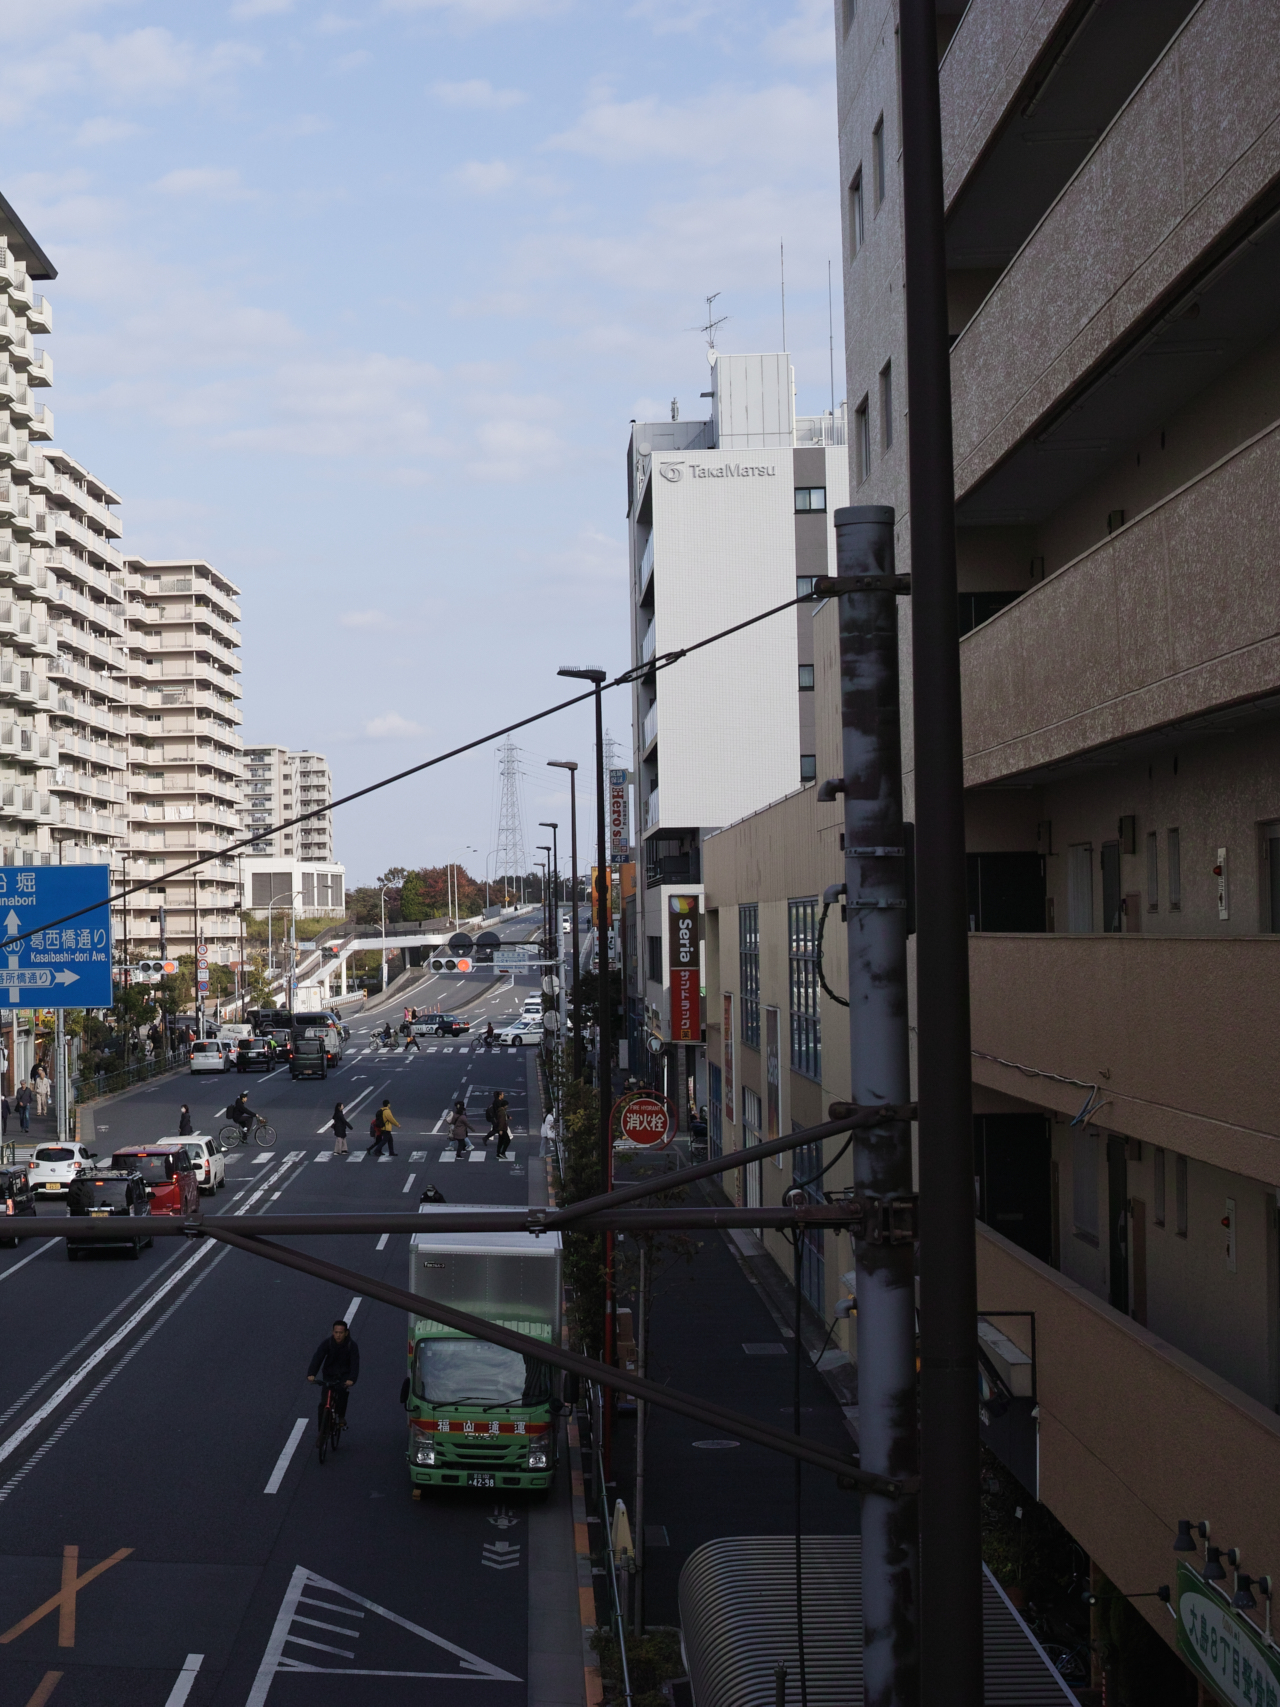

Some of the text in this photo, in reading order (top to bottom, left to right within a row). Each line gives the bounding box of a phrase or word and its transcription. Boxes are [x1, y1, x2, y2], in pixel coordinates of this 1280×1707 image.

[689, 463, 775, 479] TakaMatsu
[612, 787, 624, 838] Hero's
[615, 855, 626, 863] 4F
[30, 929, 107, 950] 葛西橋通り
[679, 918, 695, 963] Seria
[30, 950, 108, 963] Kasaibashi-dori Ave.
[680, 970, 691, 1029] サンドラッグ
[626, 1113, 665, 1132] 消火栓
[437, 1418, 527, 1435] 福山通運
[465, 1432, 498, 1441] ISUZU
[472, 1478, 495, 1487] 42-98
